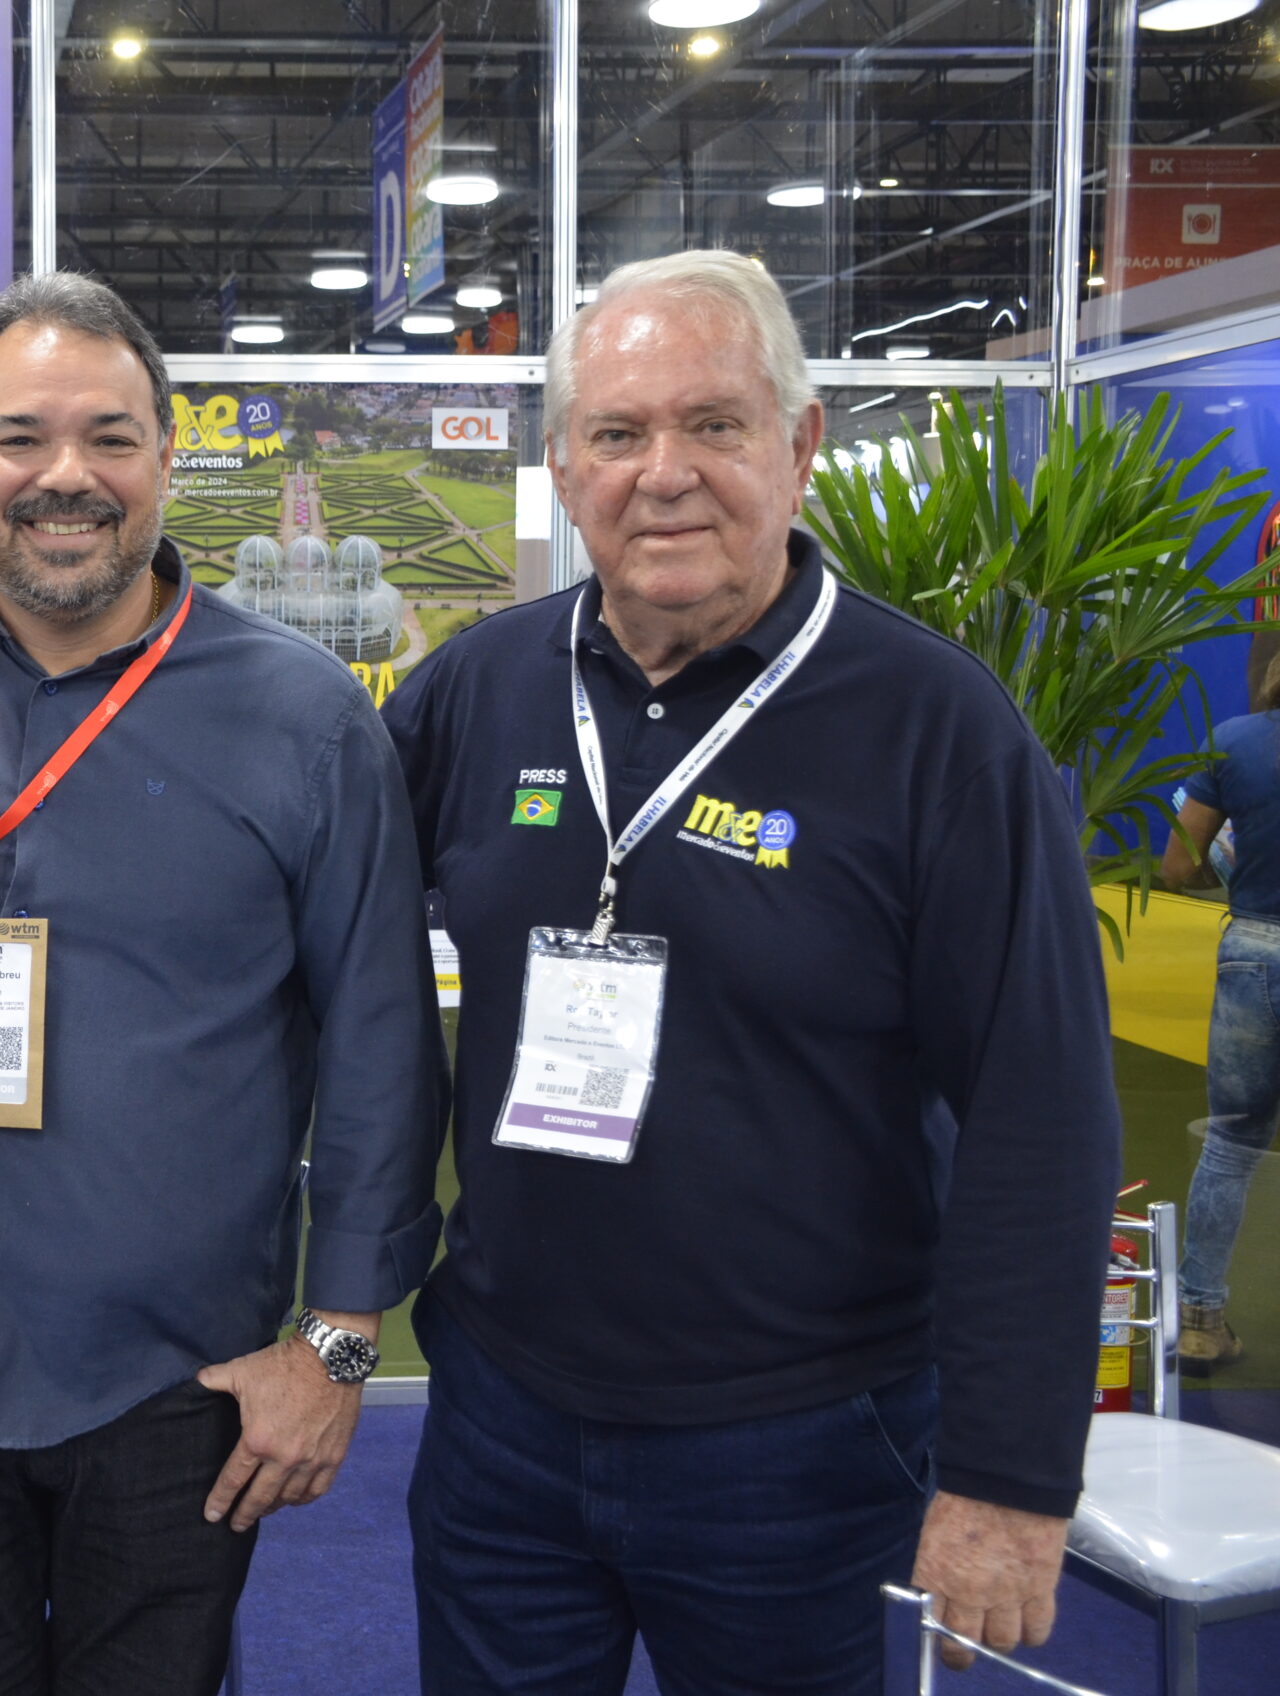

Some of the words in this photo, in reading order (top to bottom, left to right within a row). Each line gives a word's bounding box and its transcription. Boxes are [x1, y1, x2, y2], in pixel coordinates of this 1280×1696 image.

[380, 169, 402, 302] D
[1115, 257, 1160, 269] PRAÇA
[1164, 257, 1183, 268] DE
[246, 402, 272, 423] 20
[251, 421, 273, 431] ANOS
[441, 416, 500, 441] GOL
[172, 453, 243, 469] o&eventos
[208, 477, 227, 486] 2024
[751, 651, 796, 698] ILHABELA
[519, 769, 567, 784] PRESS
[625, 796, 667, 843] ILHABELA
[764, 818, 788, 836] 20
[11, 922, 40, 934] wtm
[542, 1113, 598, 1129] EXHIBITOR
